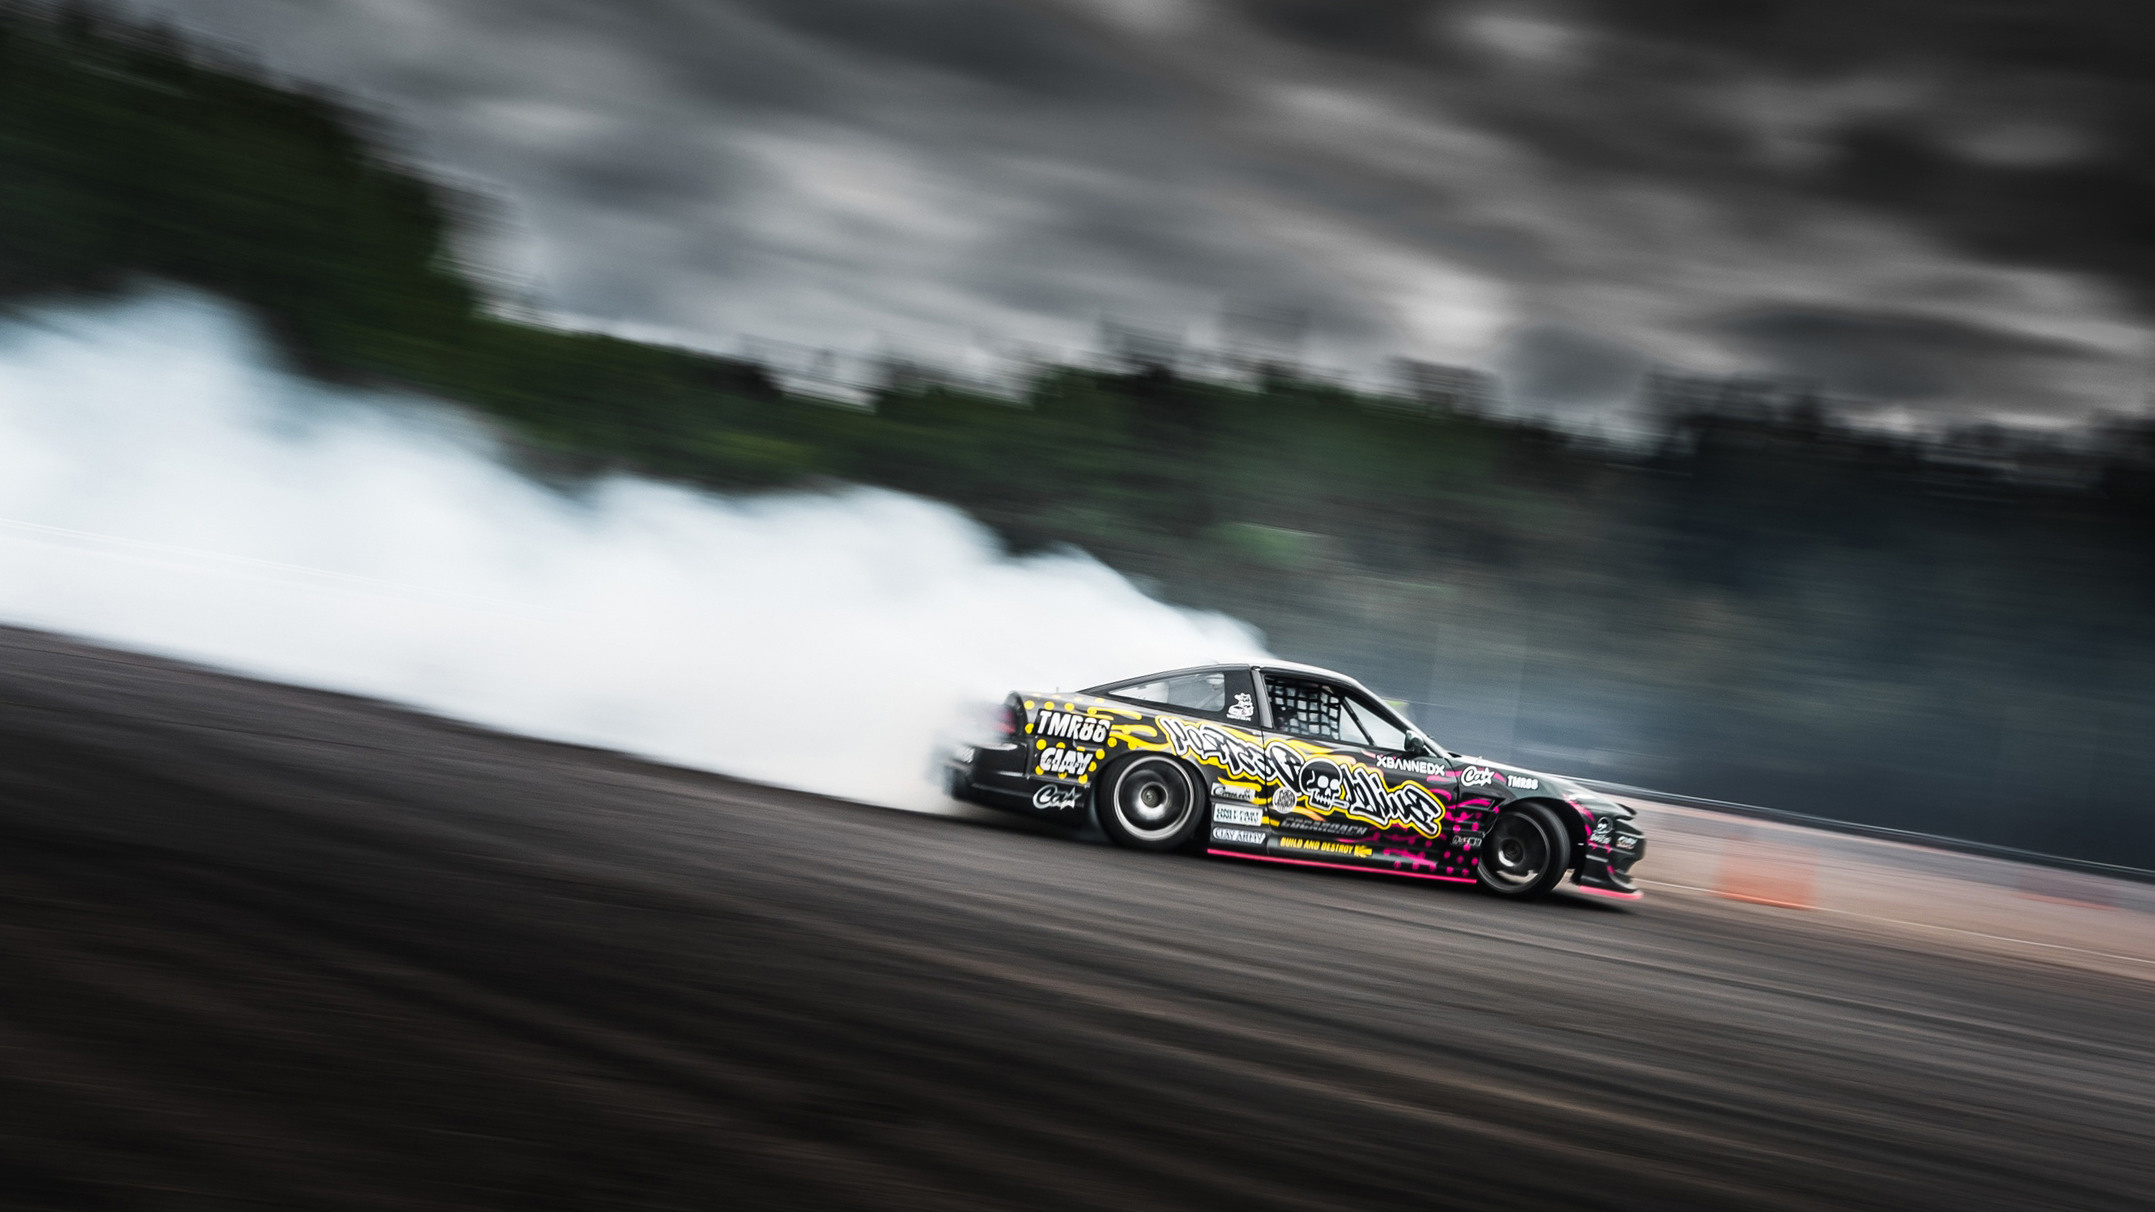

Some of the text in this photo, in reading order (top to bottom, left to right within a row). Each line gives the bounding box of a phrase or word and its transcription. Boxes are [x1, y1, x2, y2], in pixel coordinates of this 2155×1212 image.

[1037, 710, 1110, 743] TMR88
[1376, 754, 1445, 776] XBANNEDX
[1280, 836, 1353, 854] BUILD AND DESTROY
